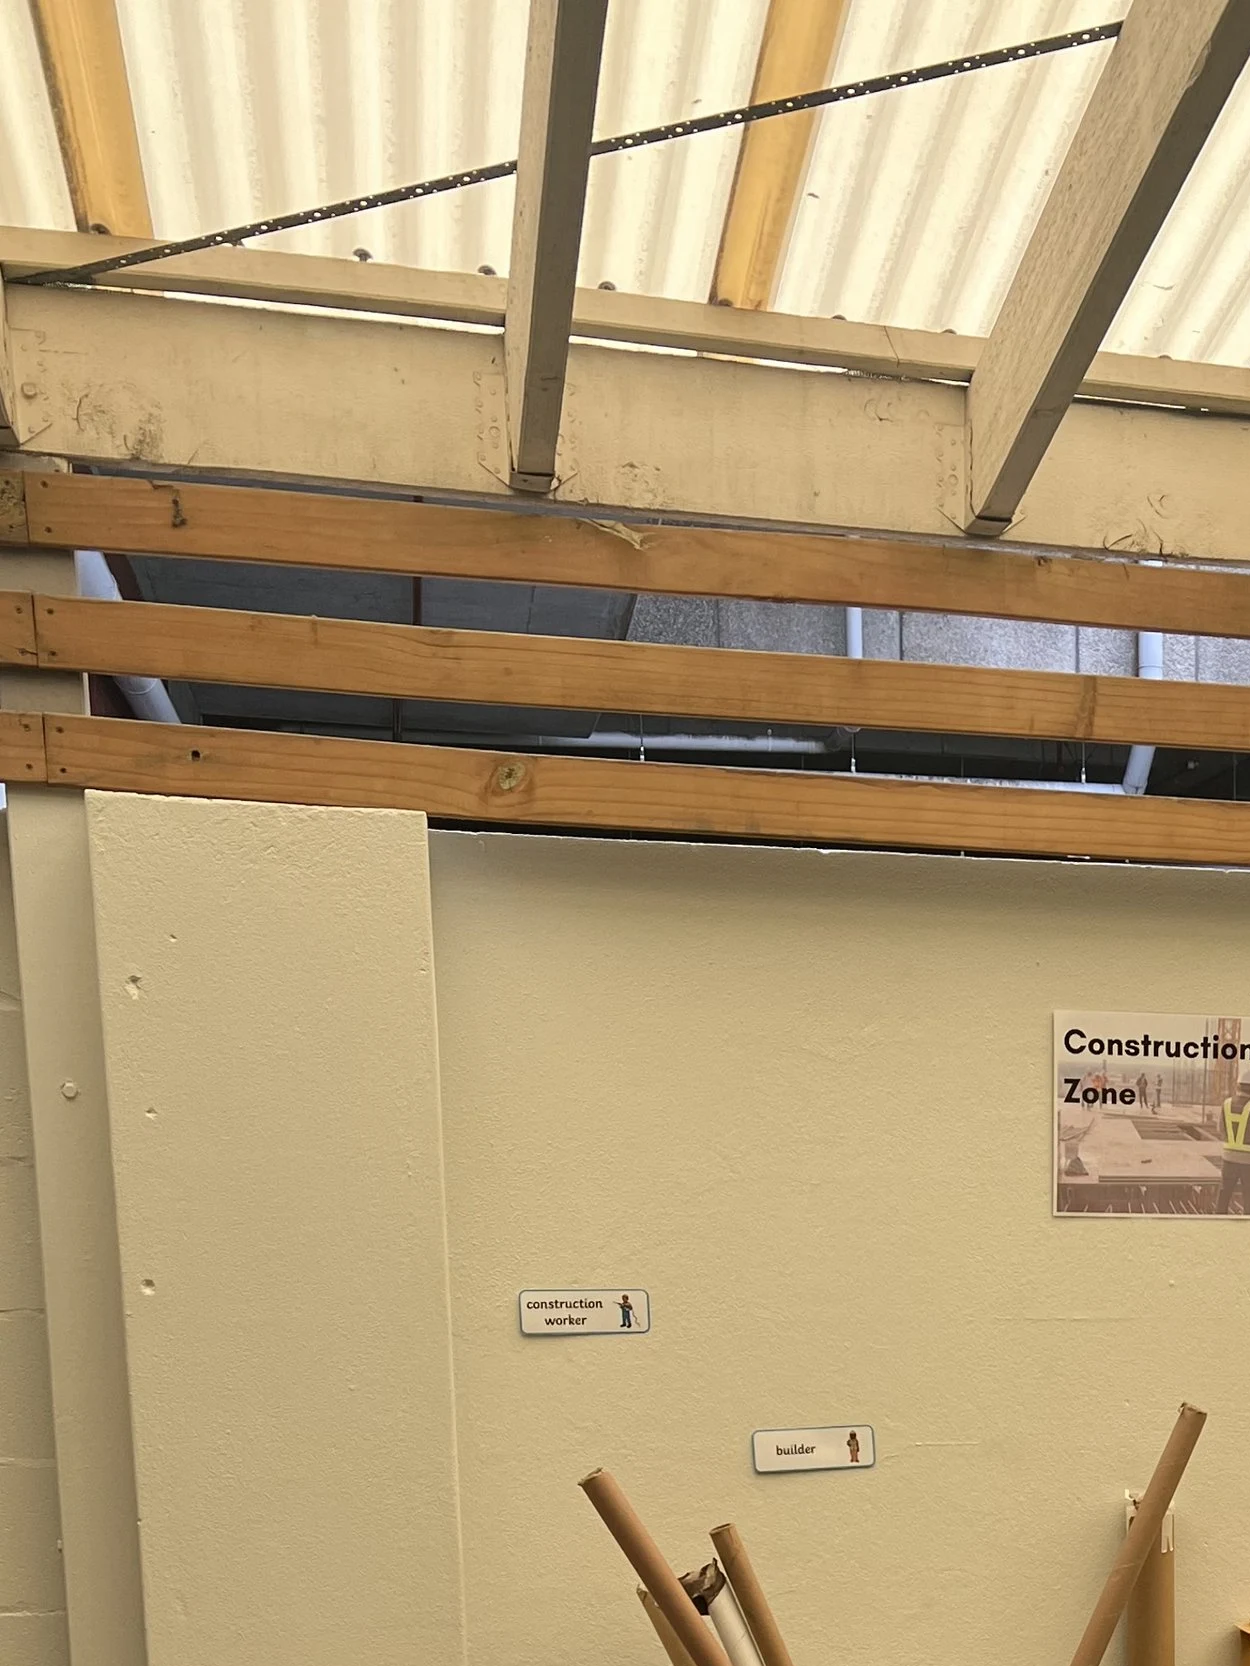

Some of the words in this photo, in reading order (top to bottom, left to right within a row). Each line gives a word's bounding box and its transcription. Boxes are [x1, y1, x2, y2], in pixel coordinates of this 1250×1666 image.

[1063, 1078, 1136, 1105] Zone
[526, 1298, 604, 1310] construction
[544, 1314, 588, 1326] worker
[775, 1443, 816, 1456] builder
